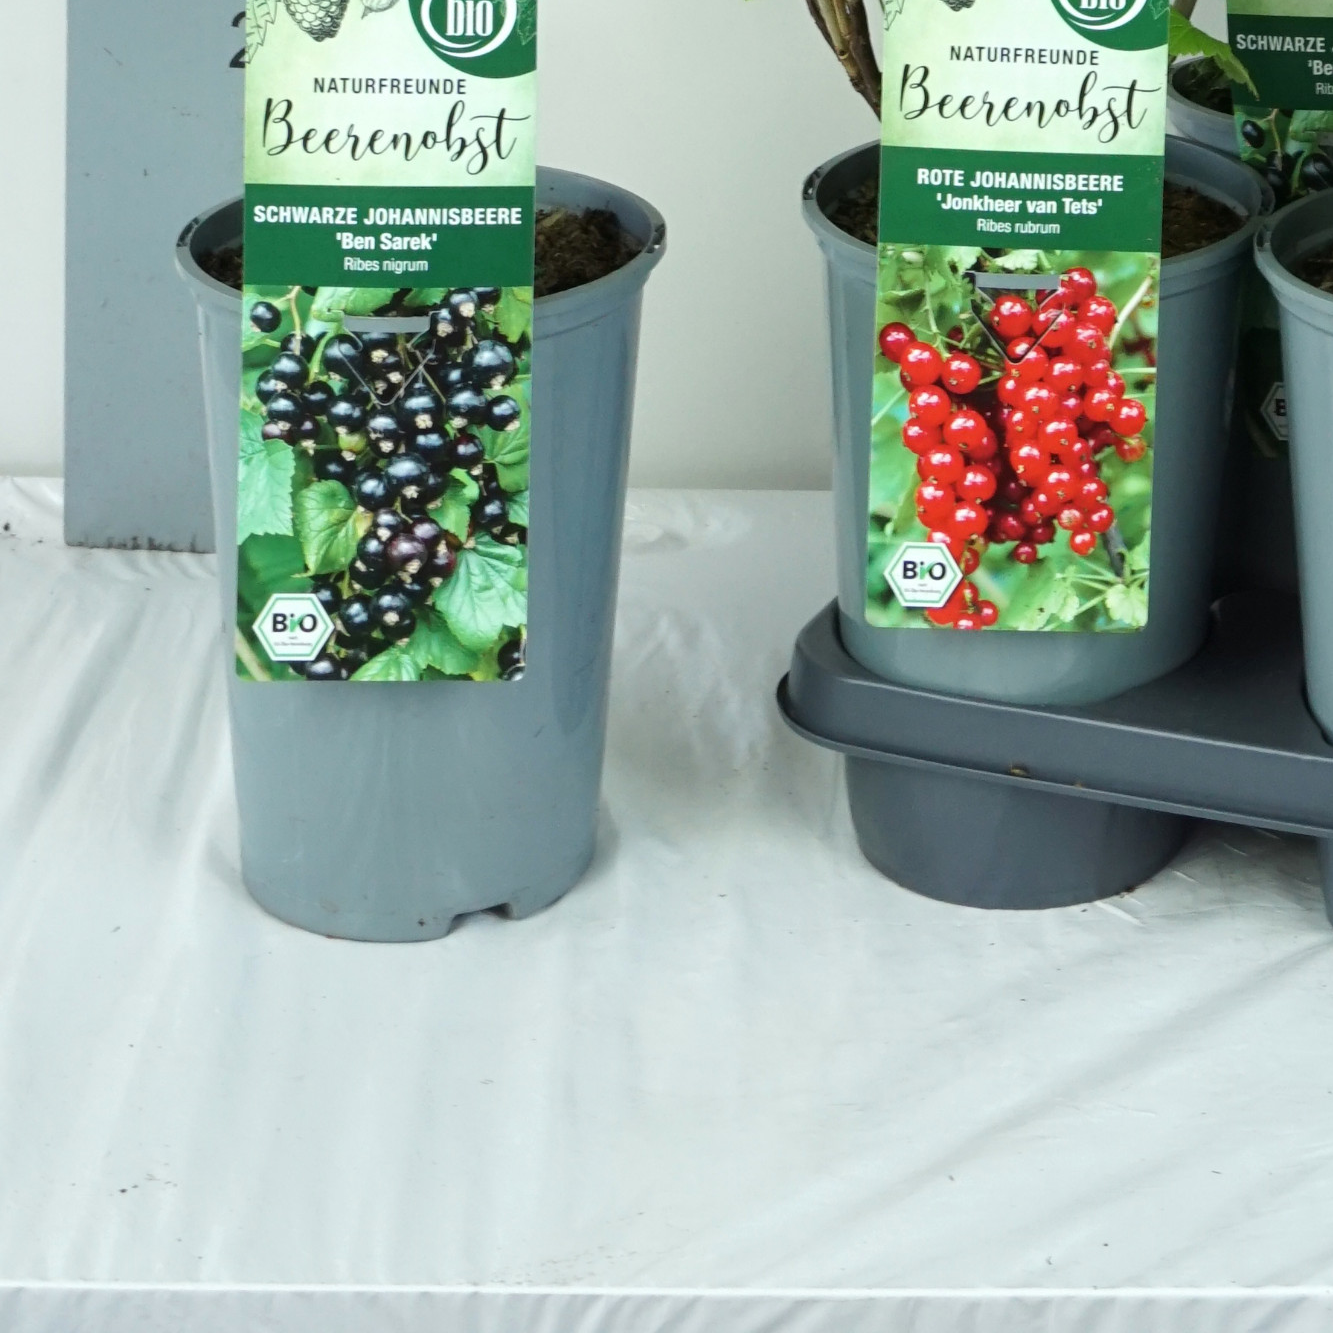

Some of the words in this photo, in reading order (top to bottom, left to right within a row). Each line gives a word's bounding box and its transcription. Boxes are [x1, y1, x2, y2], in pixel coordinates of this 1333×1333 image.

[1236, 34, 1326, 53] SCHWARZE
[949, 45, 1100, 66] NATURFREUNDE
[313, 77, 467, 95] NATURFREUNDE
[900, 64, 1162, 144] Beerenobst
[262, 97, 532, 175] Beerenobst
[917, 168, 965, 187] ROTE
[970, 170, 1124, 192] JOHANNISBEERE
[936, 193, 1021, 214] 'Jonkheer
[1026, 200, 1058, 214] van
[254, 205, 358, 225] SCHWARZE
[363, 207, 522, 226] JOHANNISBEERE
[976, 218, 1012, 233] Ribes
[1014, 220, 1061, 235] rubrum
[336, 232, 375, 250] 'Ben
[379, 232, 437, 251] Sarek'
[343, 257, 380, 272] Ribes
[382, 257, 429, 274] nigrum
